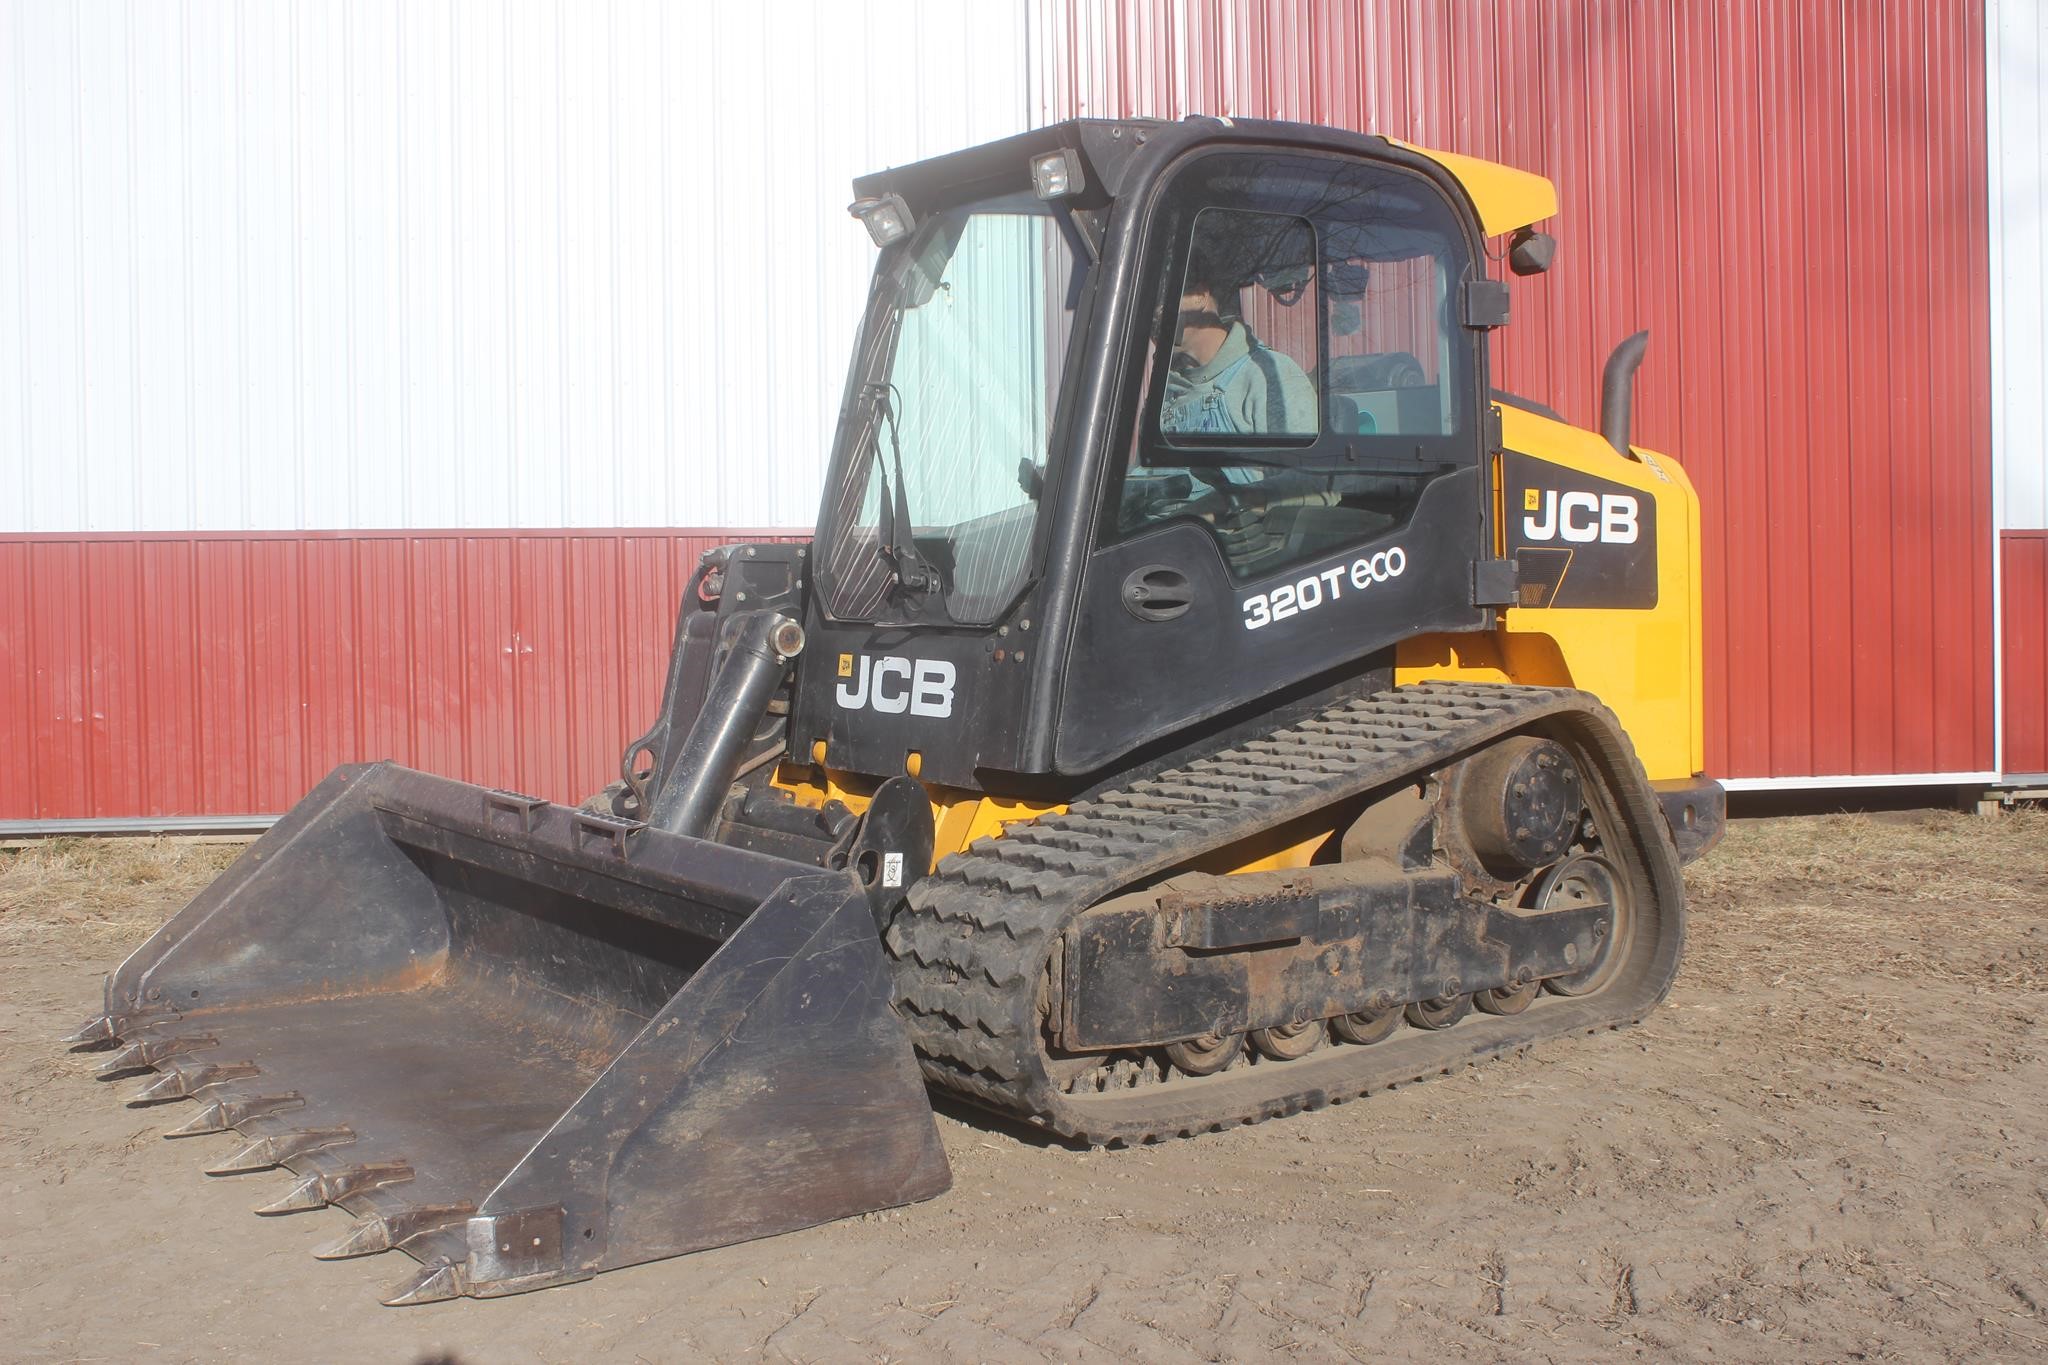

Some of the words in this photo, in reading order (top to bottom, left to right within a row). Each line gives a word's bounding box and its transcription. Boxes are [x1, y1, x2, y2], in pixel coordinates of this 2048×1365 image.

[1523, 490, 1639, 544] JCB
[1242, 565, 1346, 630] 320T
[1350, 546, 1406, 590] eco
[836, 655, 957, 718] JCB
